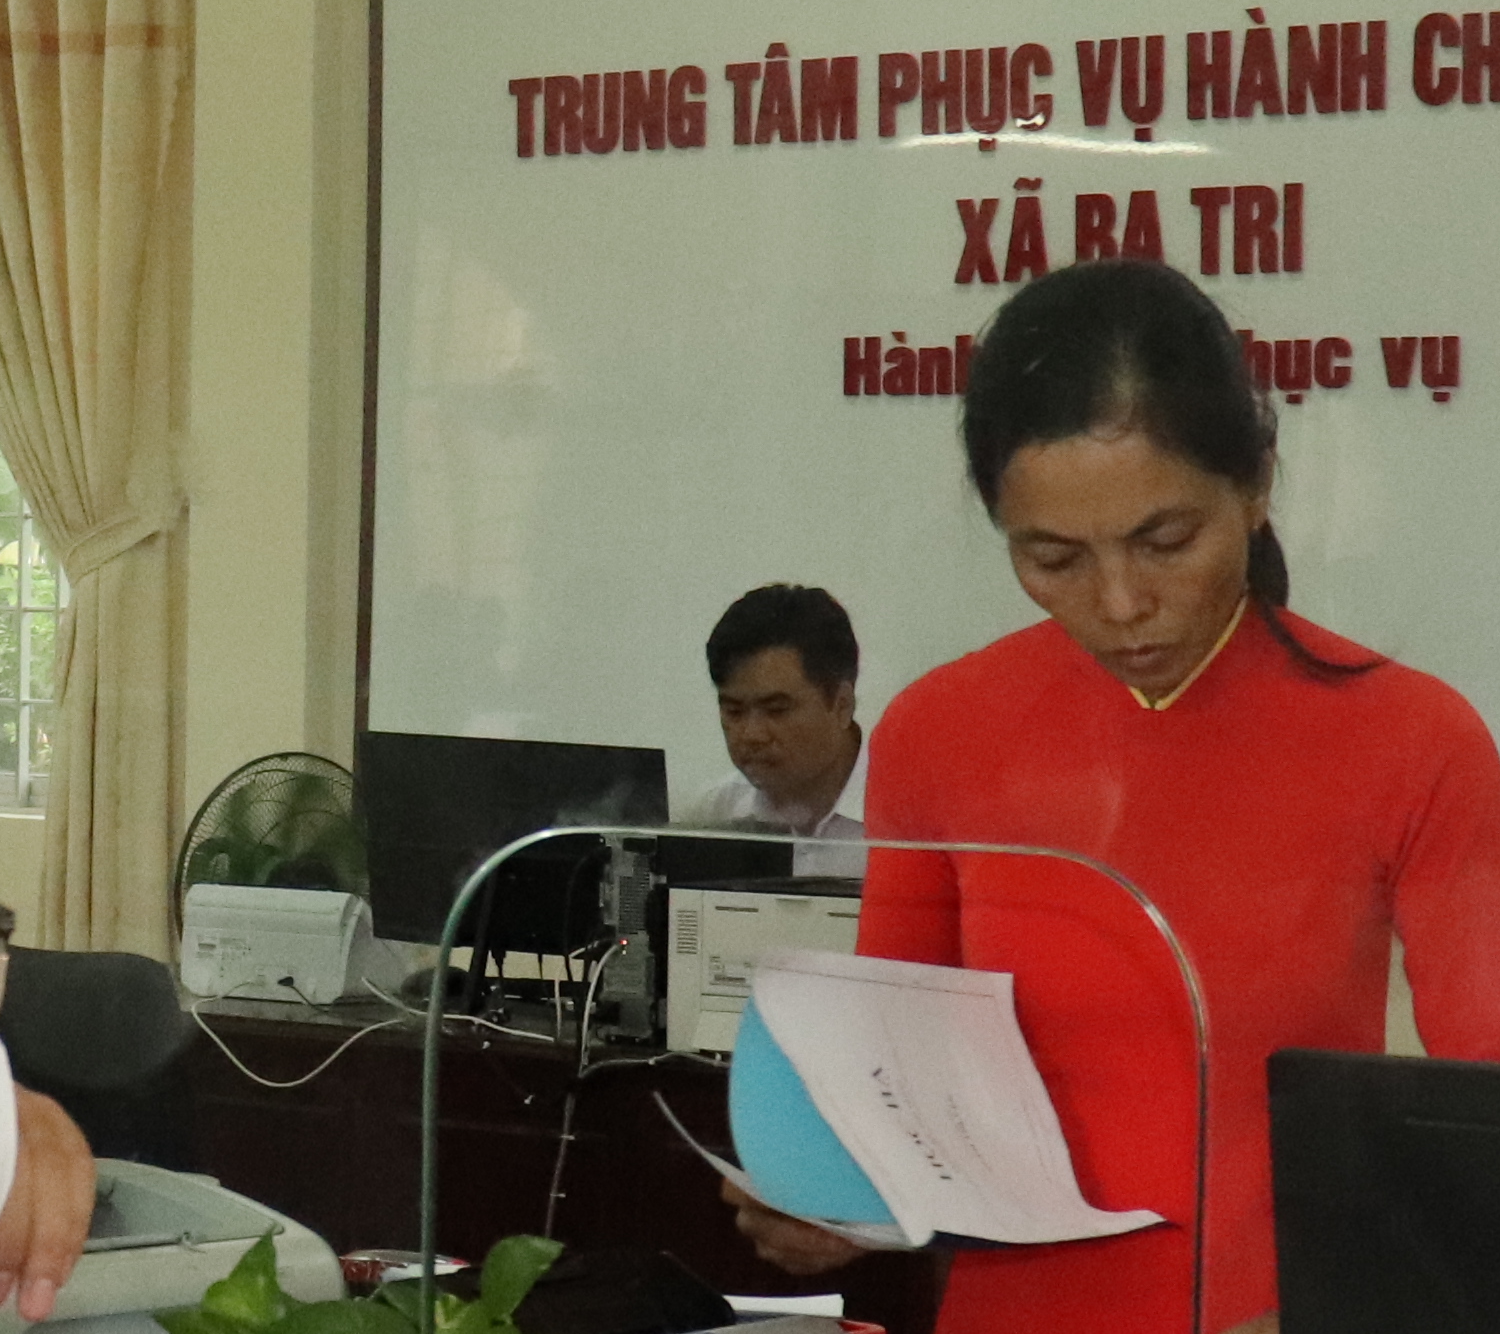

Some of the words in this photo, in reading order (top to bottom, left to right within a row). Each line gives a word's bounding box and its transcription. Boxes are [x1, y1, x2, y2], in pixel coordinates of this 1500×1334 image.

[509, 66, 707, 158] TRUNG
[726, 42, 859, 145] TÂM
[878, 43, 1053, 151] PHỤC
[1076, 35, 1165, 141] VỤ
[1187, 7, 1387, 120] HÀNH
[955, 176, 1050, 284] XÃ
[1190, 182, 1304, 275] TRI
[1236, 329, 1353, 404] hục
[1380, 335, 1461, 402] vụ
